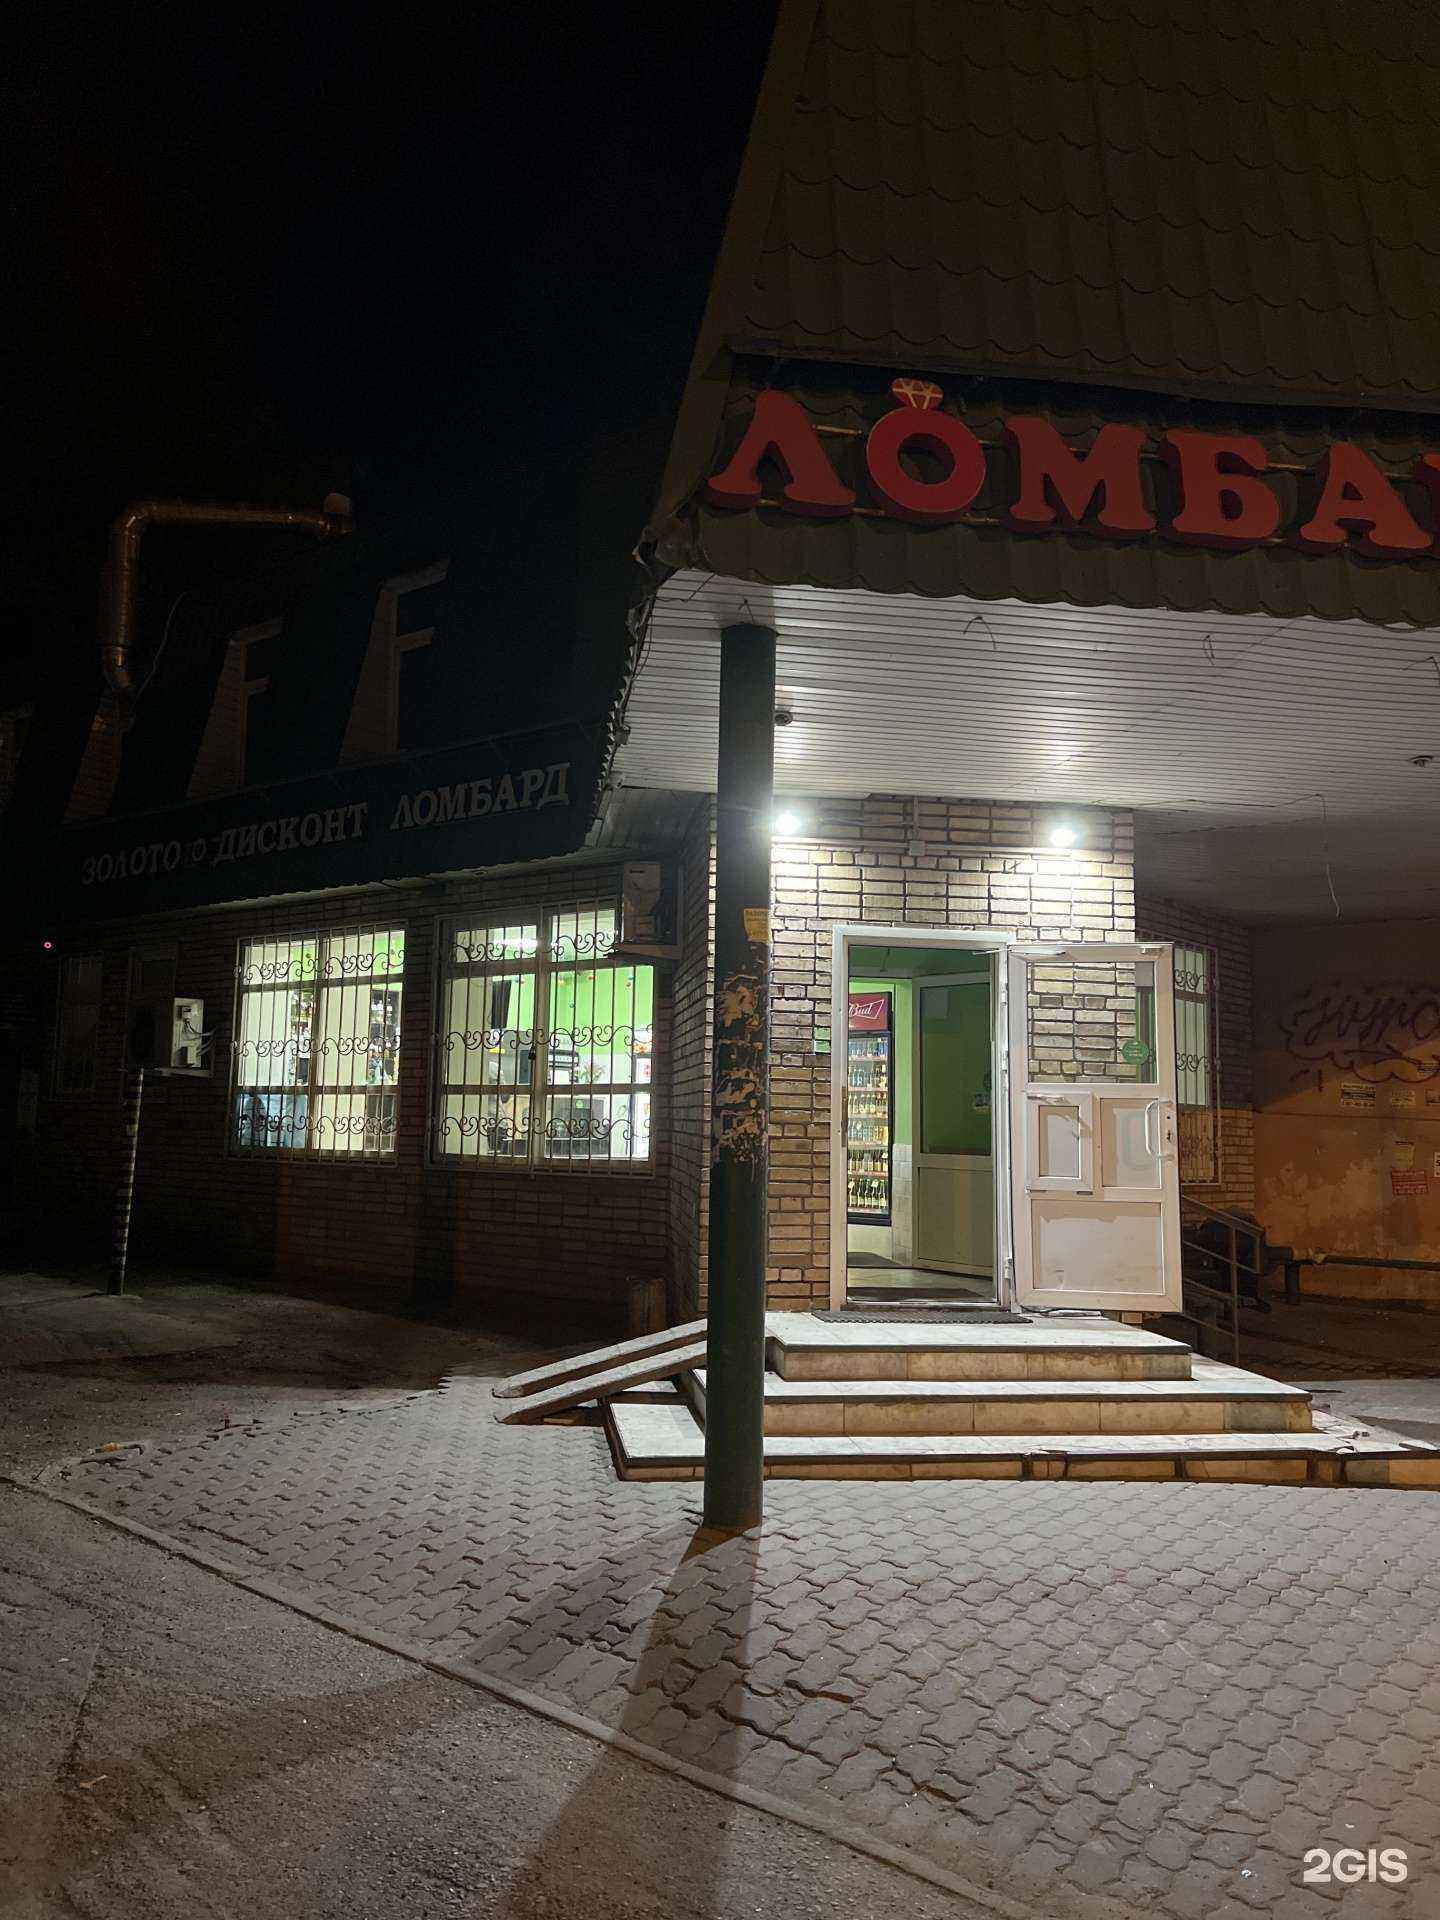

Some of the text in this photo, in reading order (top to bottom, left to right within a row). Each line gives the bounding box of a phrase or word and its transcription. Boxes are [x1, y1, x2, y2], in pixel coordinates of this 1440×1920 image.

[707, 391, 1440, 556] ЛОМБА
[80, 761, 573, 886] ЗОЛОТО ДИСКОНТ ЛОМБАРД
[848, 1002, 873, 1017] Bud
